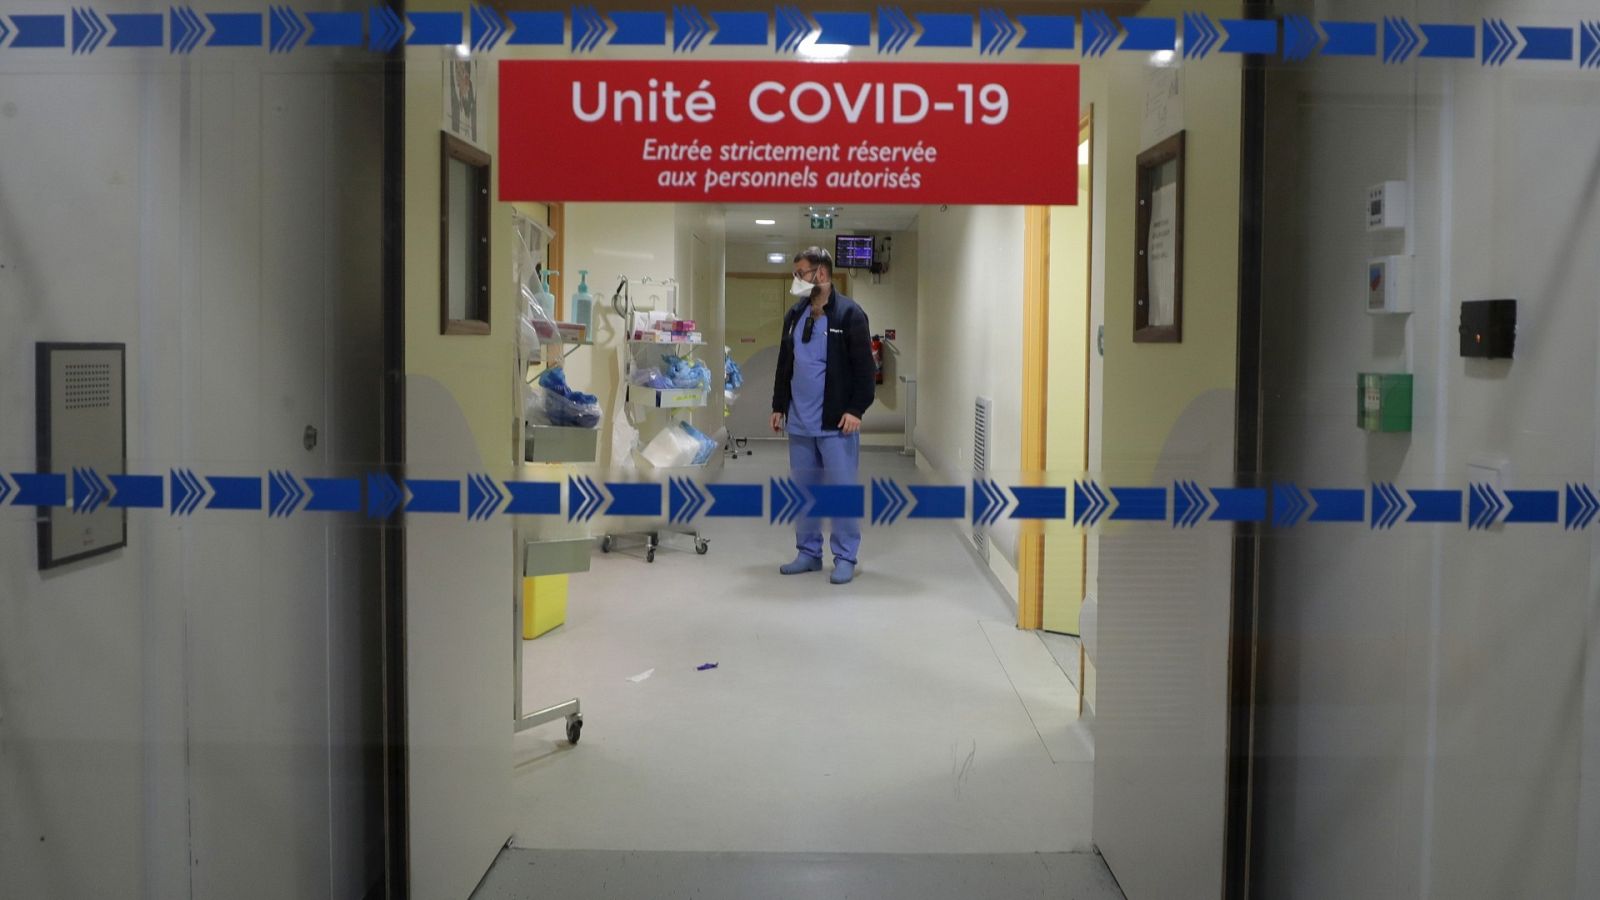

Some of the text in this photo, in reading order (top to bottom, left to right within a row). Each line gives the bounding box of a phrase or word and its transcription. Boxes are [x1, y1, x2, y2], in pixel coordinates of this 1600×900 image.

[572, 78, 1009, 125] Unité COVID-19
[642, 138, 937, 163] Entrée strictement réservée
[657, 166, 921, 193] aux personnels autorisés
